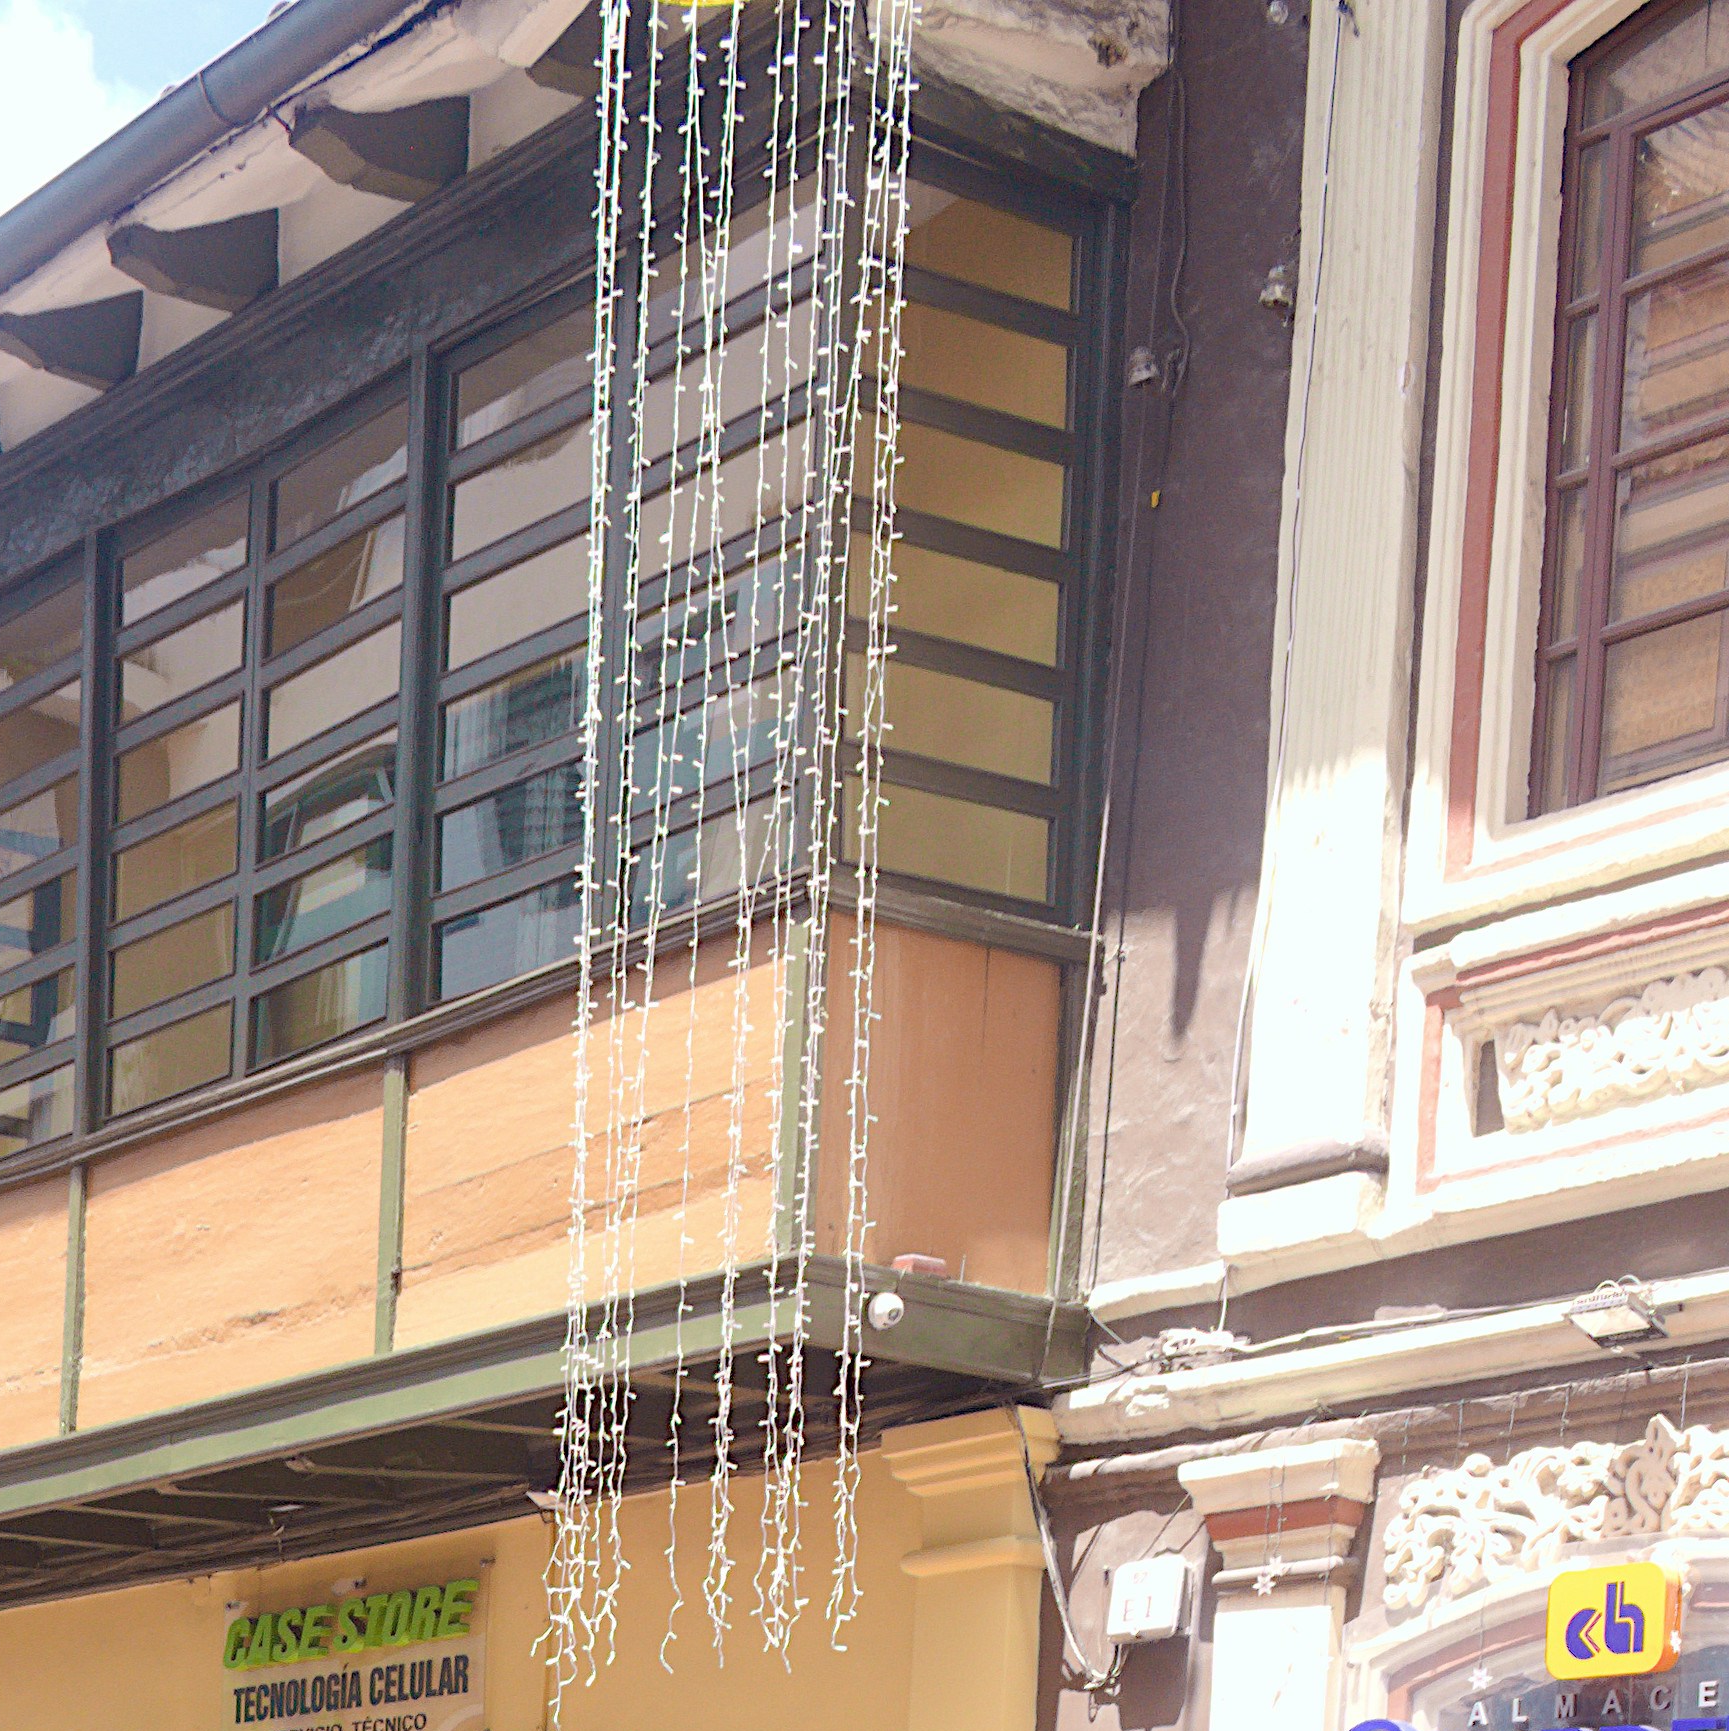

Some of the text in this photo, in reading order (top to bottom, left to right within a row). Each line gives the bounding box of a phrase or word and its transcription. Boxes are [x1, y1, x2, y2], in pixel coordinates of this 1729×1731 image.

[223, 1579, 480, 1671] CASE STORE
[233, 1654, 470, 1724] TECNOLOGÍA CELULAR
